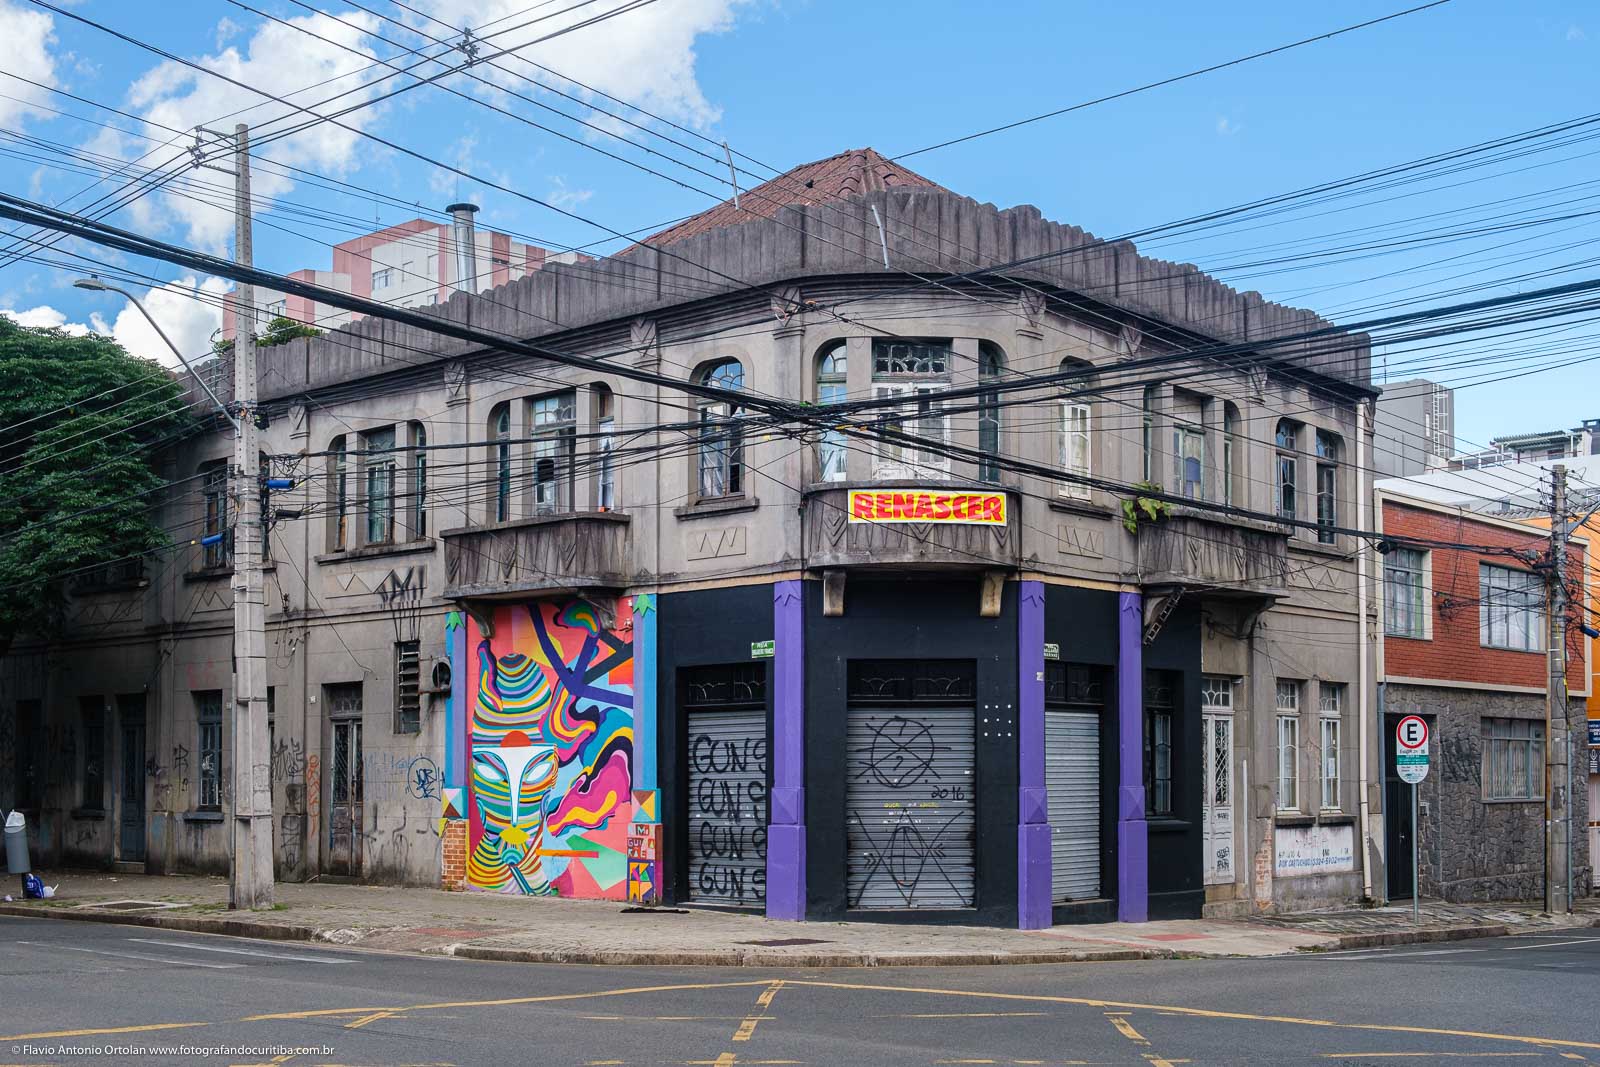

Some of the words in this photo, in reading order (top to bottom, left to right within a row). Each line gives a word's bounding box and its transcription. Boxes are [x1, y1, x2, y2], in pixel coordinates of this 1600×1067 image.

[853, 493, 1003, 522] RENASCER
[1406, 723, 1418, 741] E
[931, 785, 965, 800] 2016
